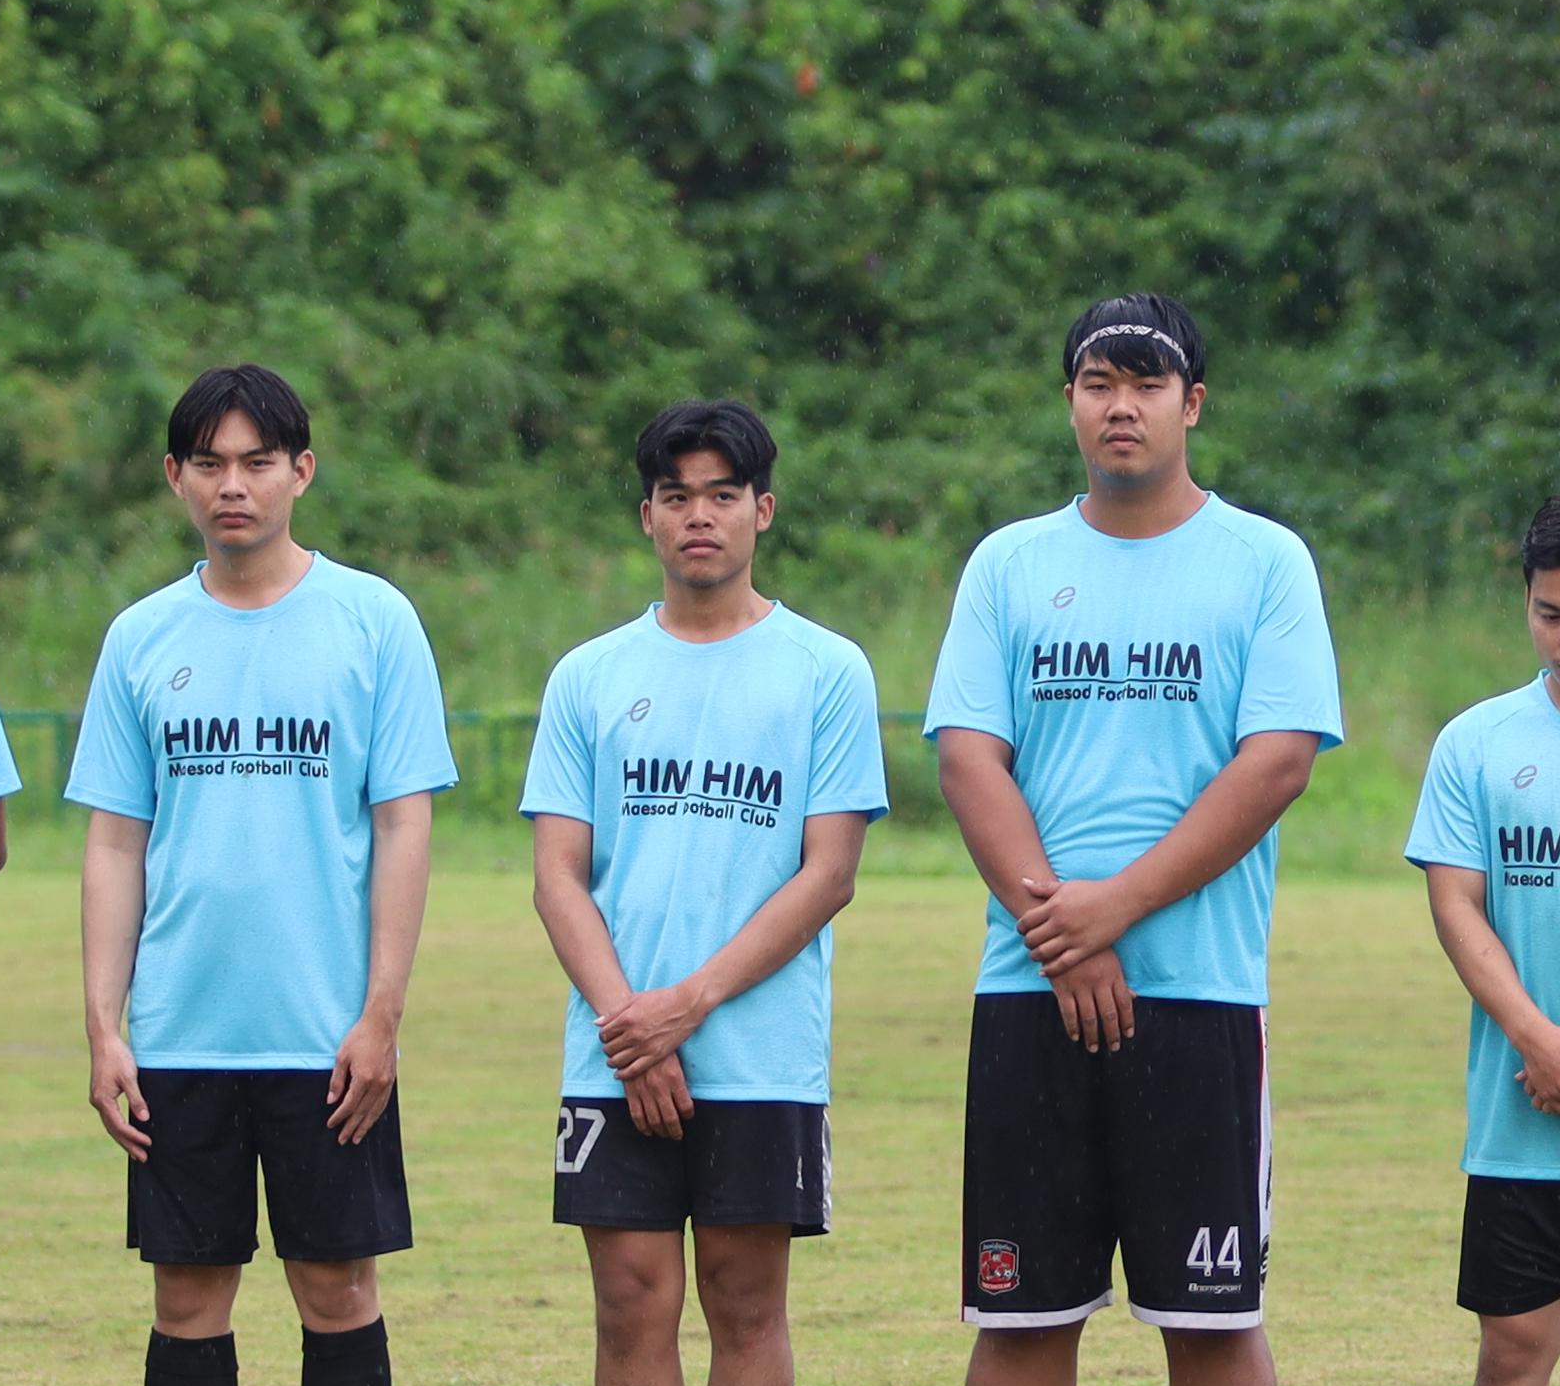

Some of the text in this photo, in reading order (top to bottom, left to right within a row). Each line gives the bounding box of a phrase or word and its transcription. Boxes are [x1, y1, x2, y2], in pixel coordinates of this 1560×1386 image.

[1032, 641, 1202, 680] HIM HIM
[1163, 685, 1198, 702] Club
[164, 717, 330, 755] HIM HIM
[231, 760, 292, 775] Football
[299, 761, 329, 778] Club
[702, 760, 782, 806] HIM
[740, 808, 776, 828] Club
[556, 1107, 607, 1173] 27
[1186, 1226, 1242, 1277] 44
